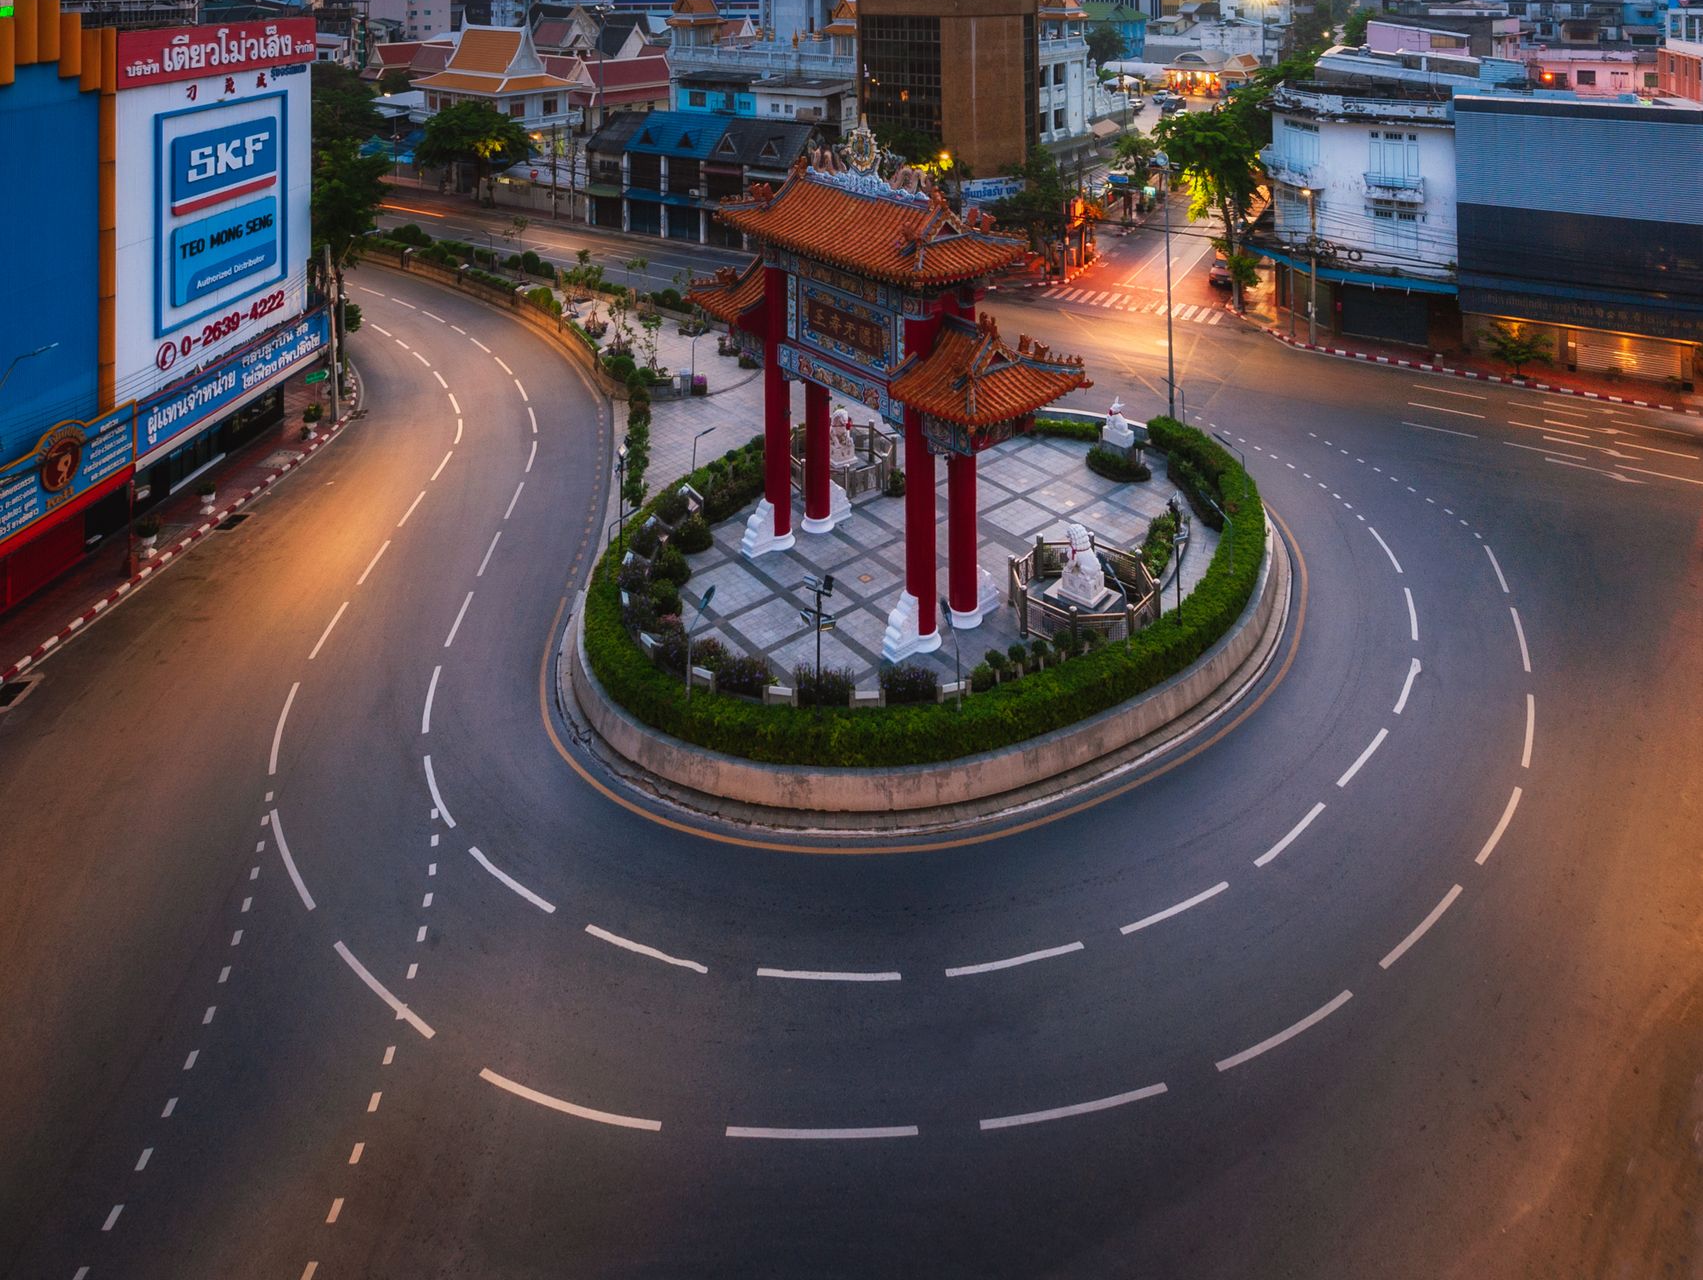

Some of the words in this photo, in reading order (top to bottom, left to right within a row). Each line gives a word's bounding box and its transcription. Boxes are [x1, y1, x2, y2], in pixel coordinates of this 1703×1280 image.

[126, 58, 160, 77] บริษัท
[294, 39, 315, 54] จำกัด
[187, 131, 270, 183] SKF
[179, 238, 206, 259] TEO
[209, 223, 243, 249] MONG
[245, 213, 273, 235] SENG
[196, 268, 233, 290] Authorized
[233, 254, 266, 273] Distributor
[180, 289, 285, 357] 0-2639-4222
[147, 370, 237, 445] ผู้แทนจำหน่าย
